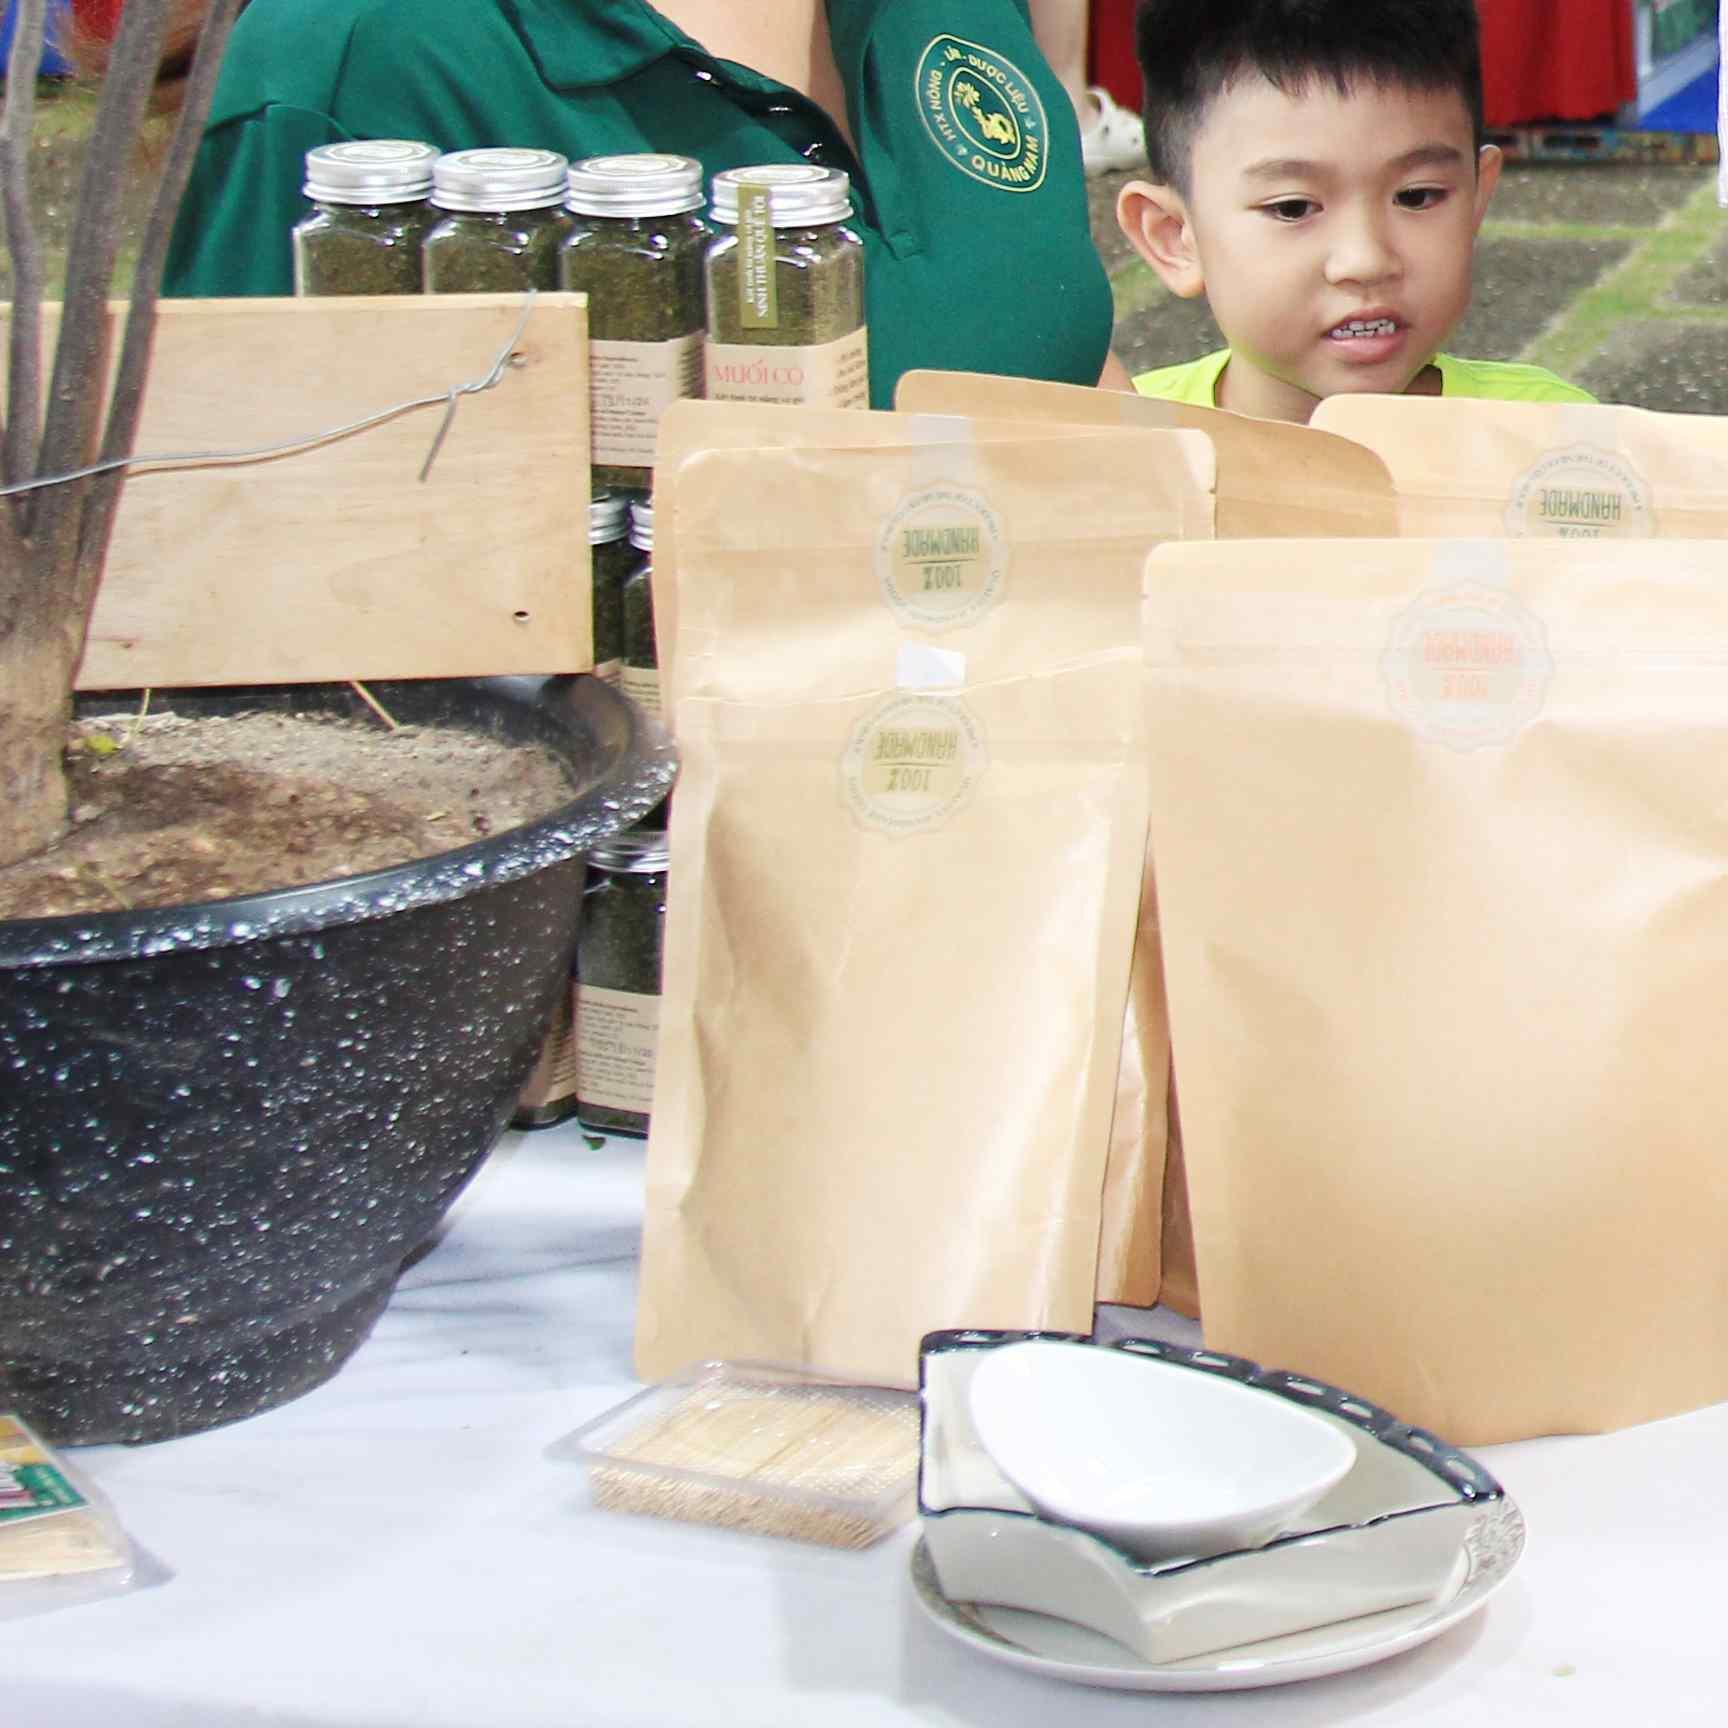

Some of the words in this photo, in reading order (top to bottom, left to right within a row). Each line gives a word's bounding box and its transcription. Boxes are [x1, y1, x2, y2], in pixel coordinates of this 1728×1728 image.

[1538, 487, 1623, 521] HANDMADE
[902, 526, 980, 558] HANDMADE
[922, 565, 962, 591] 100%
[874, 729, 958, 762] HANDMADE
[888, 768, 932, 793] 100%
